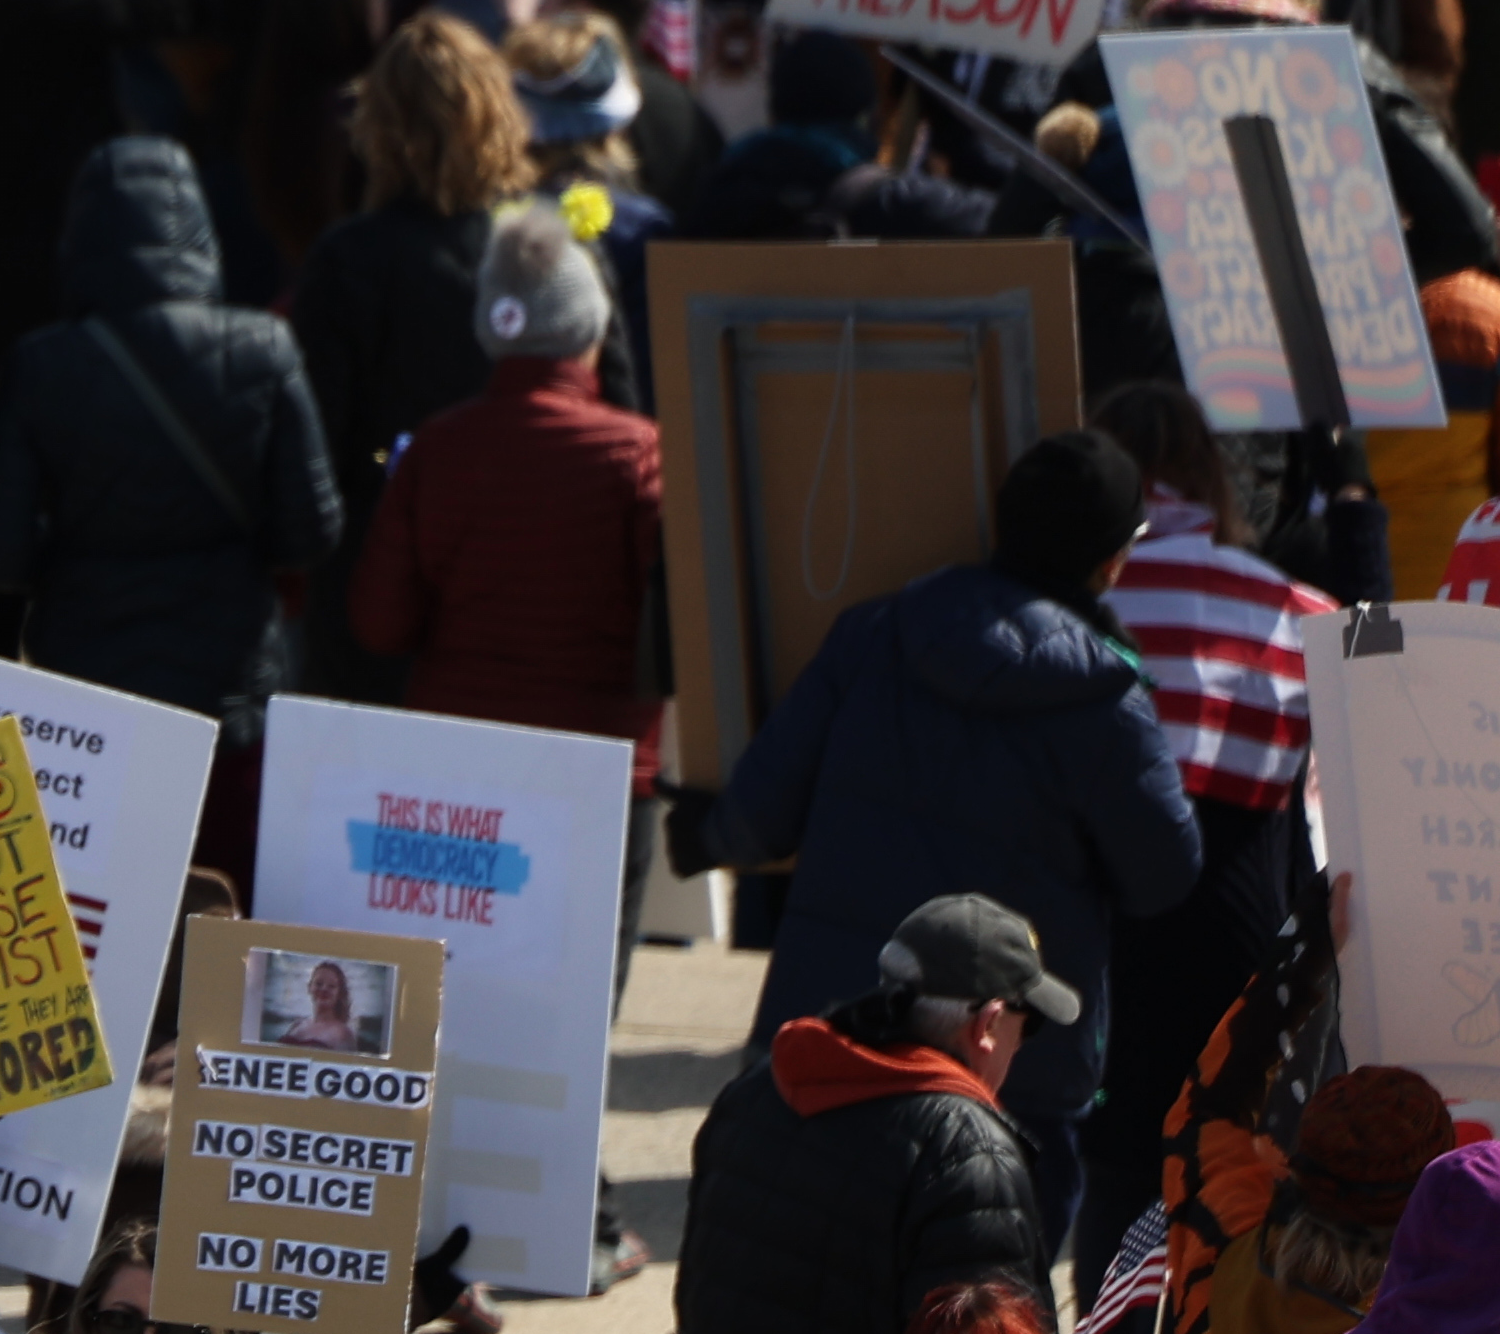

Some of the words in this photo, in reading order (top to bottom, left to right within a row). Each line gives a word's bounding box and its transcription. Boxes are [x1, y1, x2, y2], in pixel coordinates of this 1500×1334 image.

[376, 792, 419, 833] THIS
[423, 797, 441, 835] IS
[444, 802, 505, 845] WHAT
[371, 832, 501, 884] DEMOCRACY
[367, 873, 439, 919] LOOKS
[442, 882, 496, 927] LIKE
[16, 993, 62, 1029] THEY
[313, 1066, 429, 1108] GOOD
[194, 1123, 254, 1161] NO
[261, 1131, 414, 1176] SECRET
[231, 1168, 376, 1215] POLICE
[197, 1234, 256, 1272] NO
[274, 1244, 388, 1285] MORE
[235, 1281, 322, 1322] LIES
